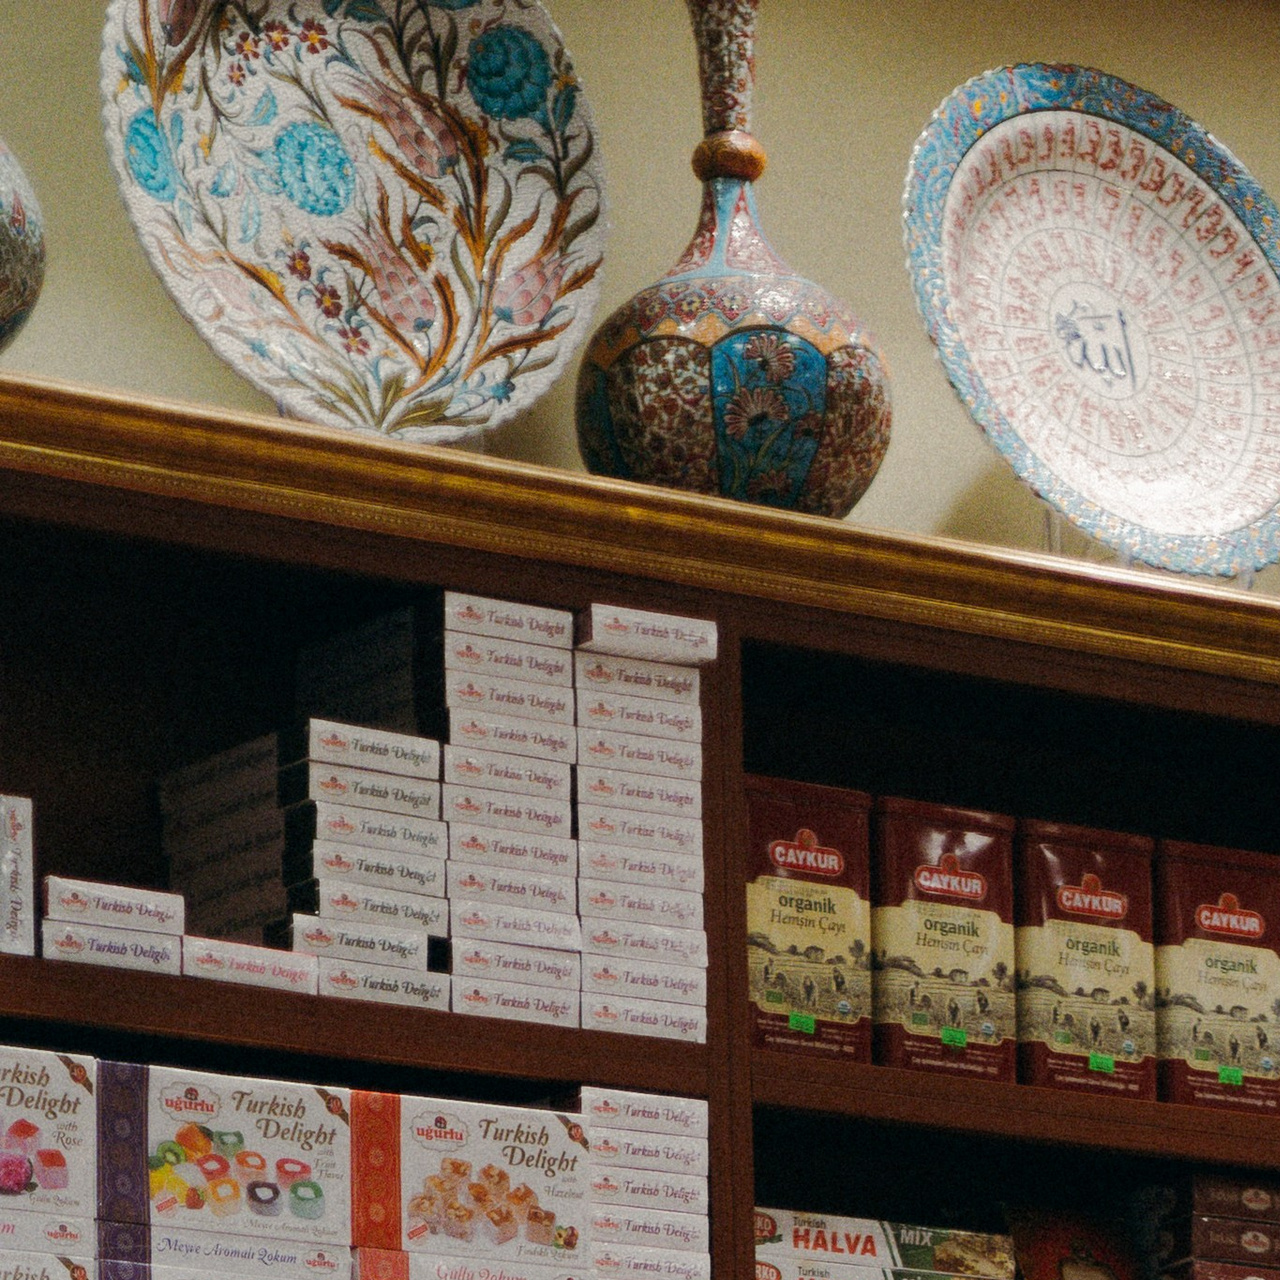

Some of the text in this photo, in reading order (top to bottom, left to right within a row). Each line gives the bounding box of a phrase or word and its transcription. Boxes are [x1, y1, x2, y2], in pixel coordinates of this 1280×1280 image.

[488, 610, 565, 637] Turkish Delight
[357, 858, 394, 876] Turkish
[779, 895, 836, 914] organik
[925, 918, 979, 937] organik
[87, 939, 170, 964] Turkish Delight
[1066, 937, 1121, 957] organik
[1206, 956, 1257, 974] organik
[362, 976, 441, 1001] Turkish Delight
[494, 993, 570, 1018] Turkish Delight
[0, 1064, 50, 1087] rkish
[0, 1086, 81, 1120] Delight
[164, 1097, 215, 1114] uğurlu
[232, 1091, 306, 1119] Turkish
[56, 1121, 77, 1132] with
[256, 1118, 337, 1150] Delight
[417, 1126, 463, 1141] uğurlu
[479, 1118, 549, 1146] Turkish
[52, 1131, 84, 1149] Rose
[503, 1145, 579, 1177] Delight
[793, 1217, 826, 1229] Turkish
[156, 1238, 200, 1255] Meyve
[792, 1227, 877, 1257] HALVA
[798, 1266, 830, 1278] Turkish
